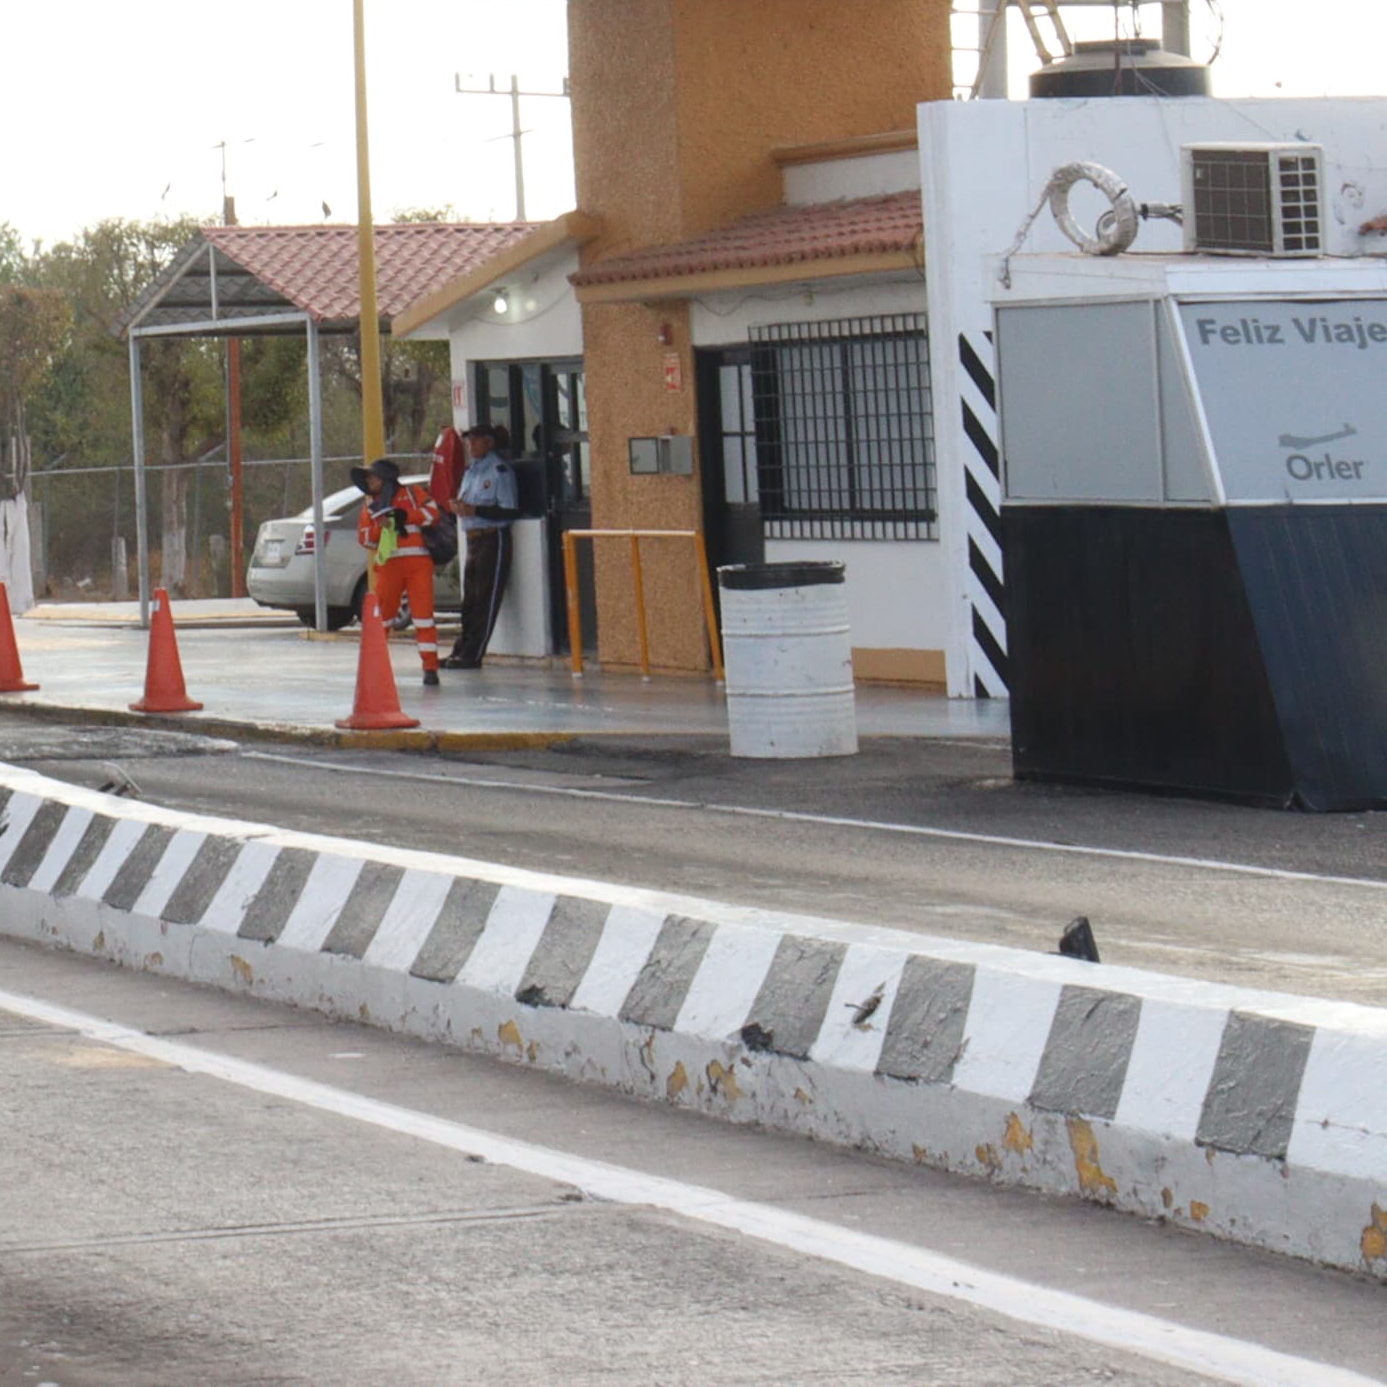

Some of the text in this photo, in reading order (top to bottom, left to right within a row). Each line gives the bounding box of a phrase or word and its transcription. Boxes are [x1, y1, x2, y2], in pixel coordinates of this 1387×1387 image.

[1196, 316, 1387, 350] Feliz Viaje
[1285, 452, 1366, 481] Orler
